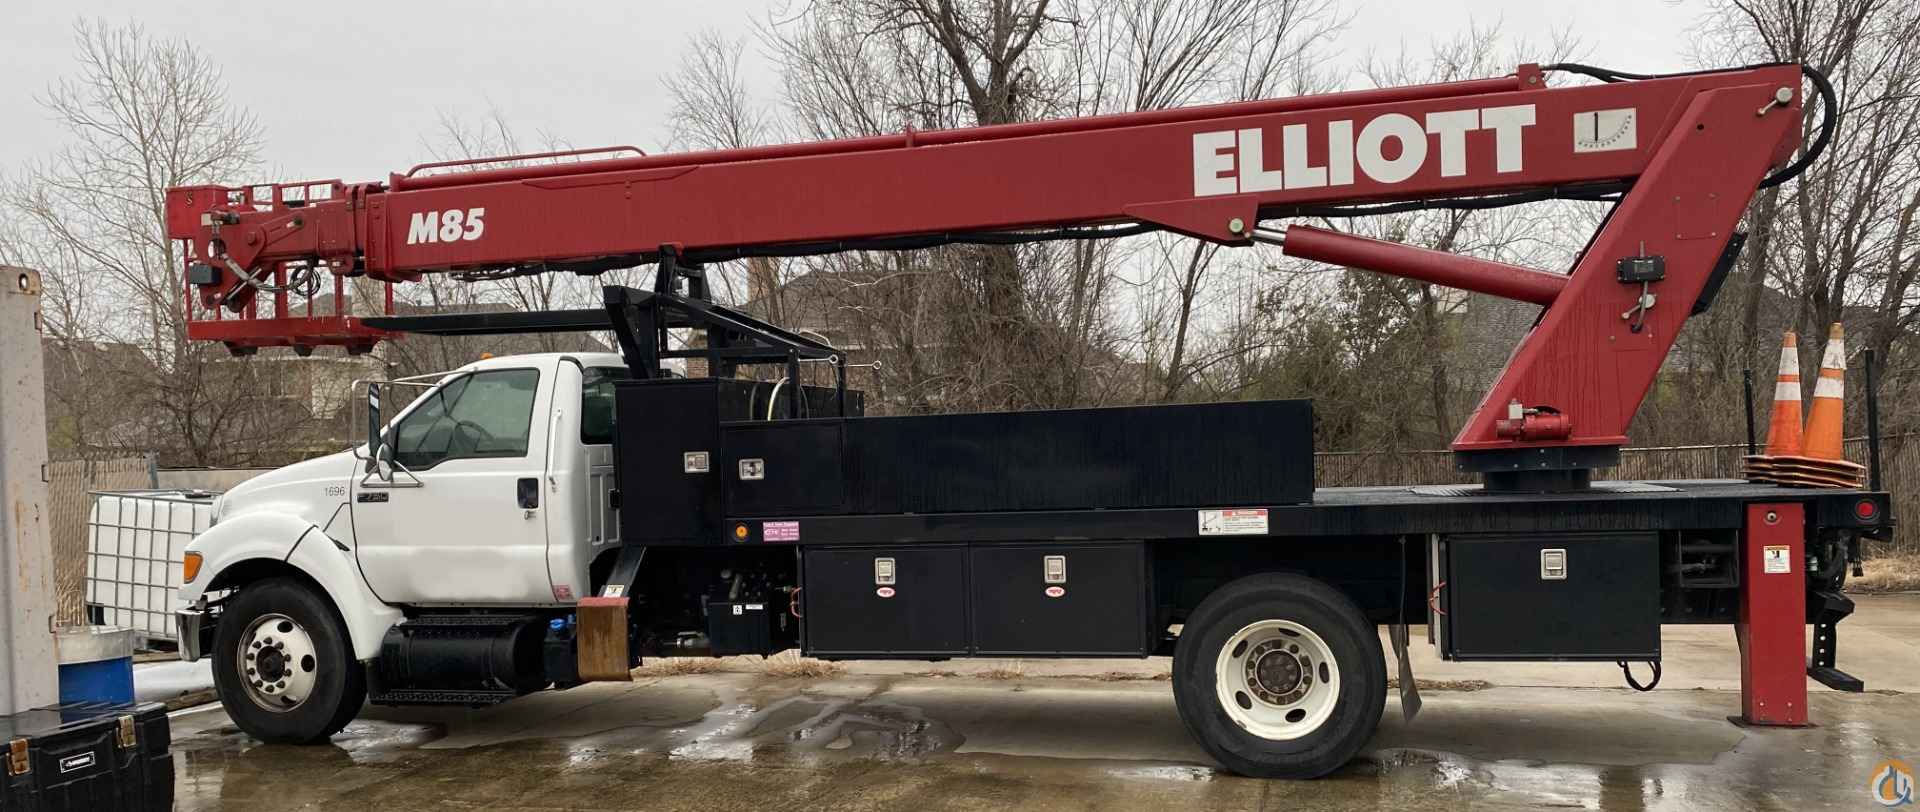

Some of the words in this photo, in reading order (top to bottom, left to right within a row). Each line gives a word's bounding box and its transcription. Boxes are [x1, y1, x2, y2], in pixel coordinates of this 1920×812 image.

[1193, 103, 1536, 197] ELLIOTT
[407, 207, 485, 245] M85
[325, 486, 345, 497] 1696
